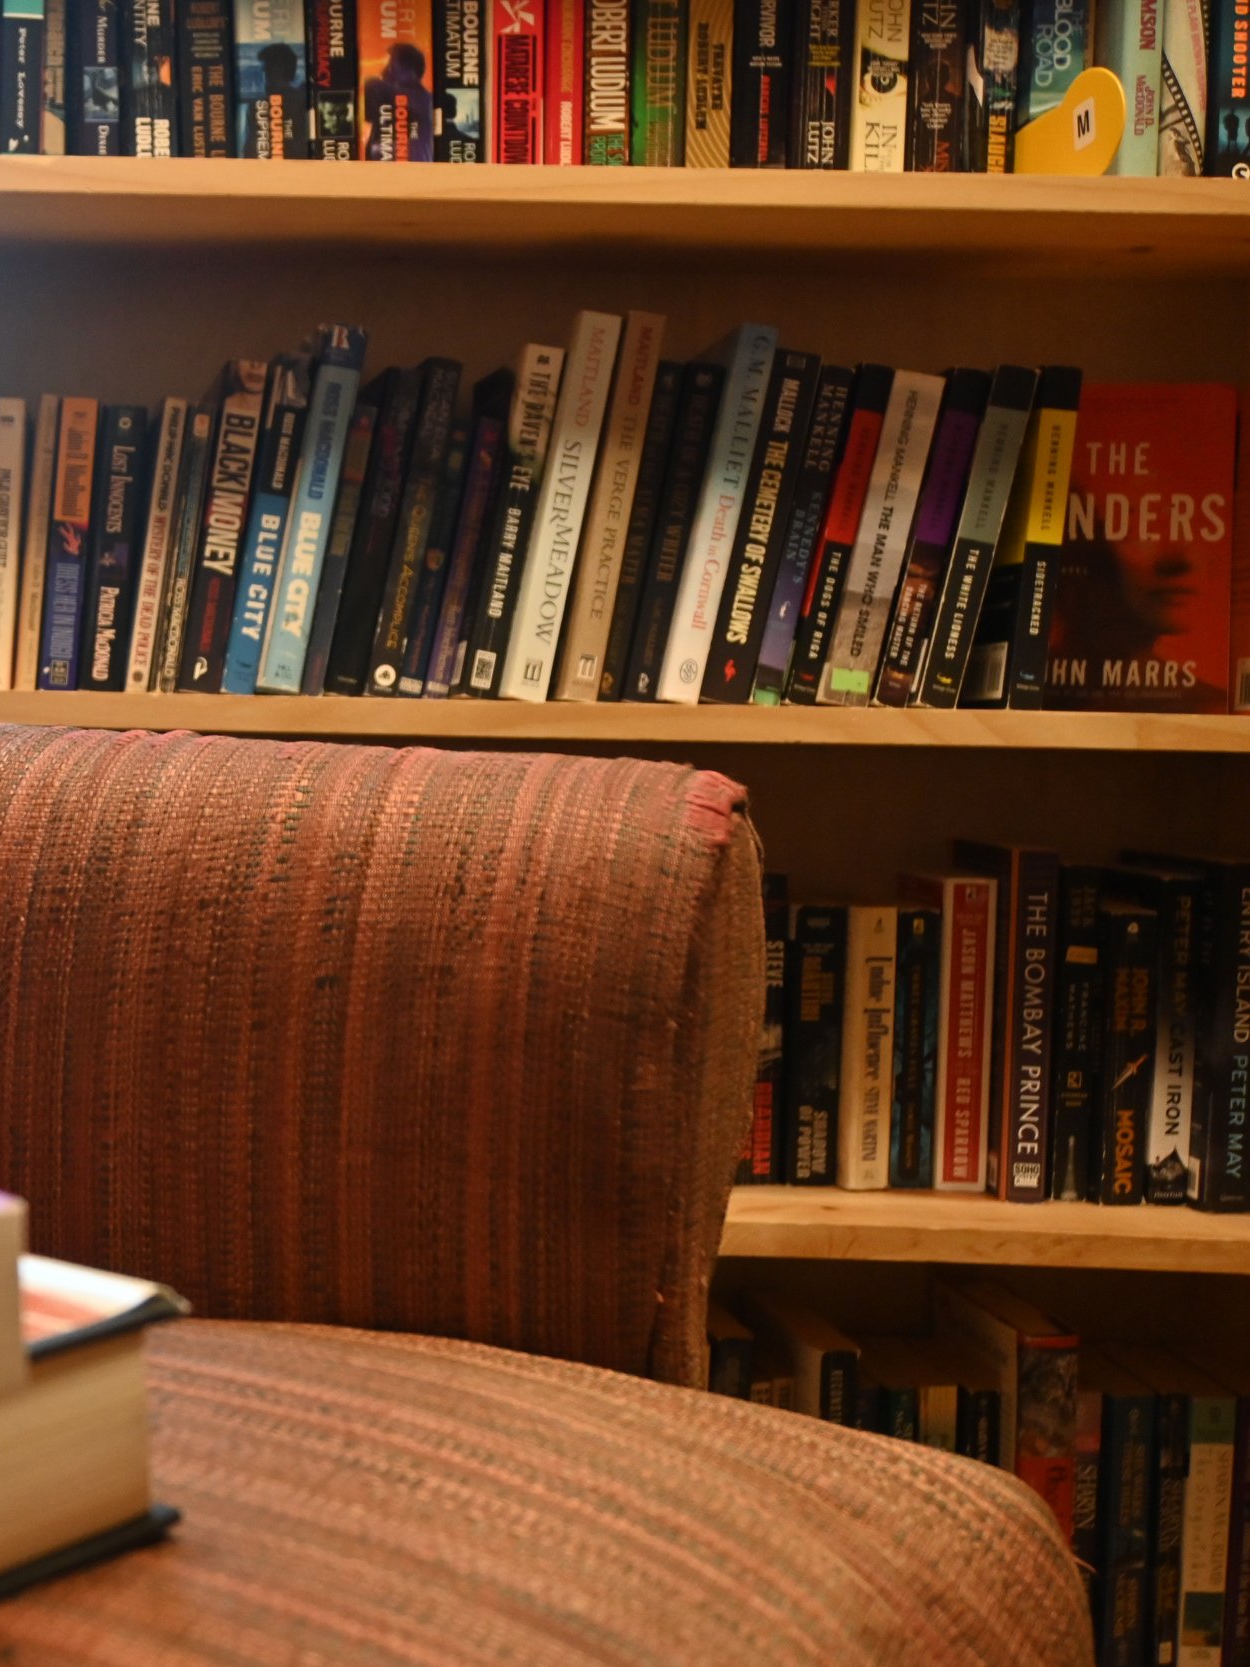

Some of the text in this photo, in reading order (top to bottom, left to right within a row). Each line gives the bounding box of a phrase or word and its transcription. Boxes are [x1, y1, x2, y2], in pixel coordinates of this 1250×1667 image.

[463, 1, 479, 85] BOURNE
[646, 17, 678, 108] LUDLUM
[1035, 24, 1052, 87] ROAD
[1053, 0, 1071, 71] BLOOD
[1231, 20, 1248, 98] SHOOTER
[192, 66, 204, 121] ERIC VAN
[209, 64, 225, 142] THE BOURNE
[590, 56, 626, 131] LUDLUM
[696, 22, 709, 130] ROBERT LUDLUM
[712, 43, 724, 110] TREVAYNE
[1145, 85, 1155, 128] JOHN D.
[807, 122, 820, 164] LUTZ
[821, 122, 834, 164] JOHN
[882, 125, 897, 149] IN
[1076, 109, 1091, 139] M
[573, 324, 608, 429] MAITLAND
[626, 325, 653, 408] MAITLAND
[619, 413, 638, 452] THE
[723, 386, 757, 489] MALLIET
[805, 382, 833, 472] MANKELL
[818, 385, 847, 473] HENNING
[1086, 442, 1151, 476] THE
[201, 413, 257, 577] BLACK MONEY
[487, 370, 549, 620] THE EYE BARRY MAITLAND
[607, 458, 629, 521] VERGE
[710, 493, 736, 544] Death
[726, 377, 800, 646] MALLOCK THE CEMETERY OF SWALLOWS
[1068, 493, 1226, 543] NDERS
[251, 512, 282, 577] BLUE
[289, 510, 322, 579] BLUE
[849, 389, 918, 658] HENNING MANKELL THE MAN WHO SMILED
[54, 562, 79, 594] DRESS
[143, 578, 159, 599] THE
[145, 562, 161, 577] OF
[173, 577, 187, 605] ROSS
[590, 526, 617, 621] PRACTICE
[828, 550, 842, 574] THE
[956, 573, 973, 610] WHITE
[966, 548, 980, 571] THE
[138, 600, 156, 630] DEAD
[240, 582, 269, 642] CITY
[279, 577, 311, 638] CITY
[691, 557, 719, 632] Cornwall
[816, 610, 828, 628] OF
[820, 576, 836, 609] DOGS
[1029, 560, 1045, 636] SIDETRACKED
[943, 612, 964, 661] LIONESS
[1102, 659, 1197, 688] MARRS
[1016, 891, 1049, 1156] THE BOMBAY PRINCE
[1164, 894, 1193, 1136] PETER MAY CAST IRON
[1232, 964, 1250, 1044] ISLAND
[951, 928, 978, 1179] JASON MATTHEWS RED SPARROW
[1228, 1055, 1248, 1125] PETER
[795, 1126, 812, 1180] POWER
[1112, 1109, 1137, 1196] MOSAIC
[1224, 1132, 1245, 1179] MAY
